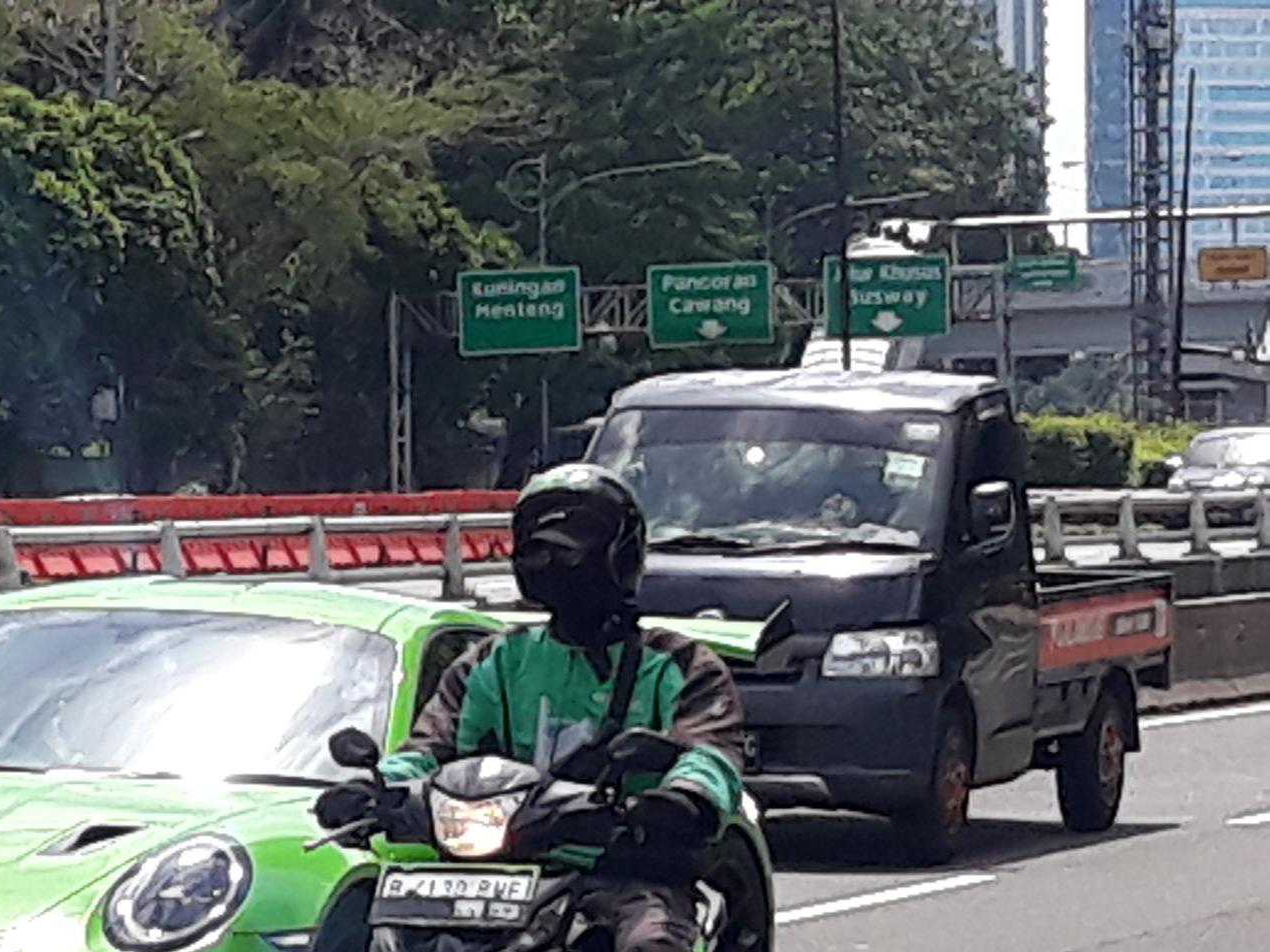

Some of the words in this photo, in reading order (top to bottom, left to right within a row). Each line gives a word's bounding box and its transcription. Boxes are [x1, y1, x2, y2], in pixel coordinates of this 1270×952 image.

[472, 279, 566, 300] Kuningan
[662, 274, 757, 292] Pancoran
[475, 302, 564, 320] Menteng
[669, 297, 751, 315] Cawang
